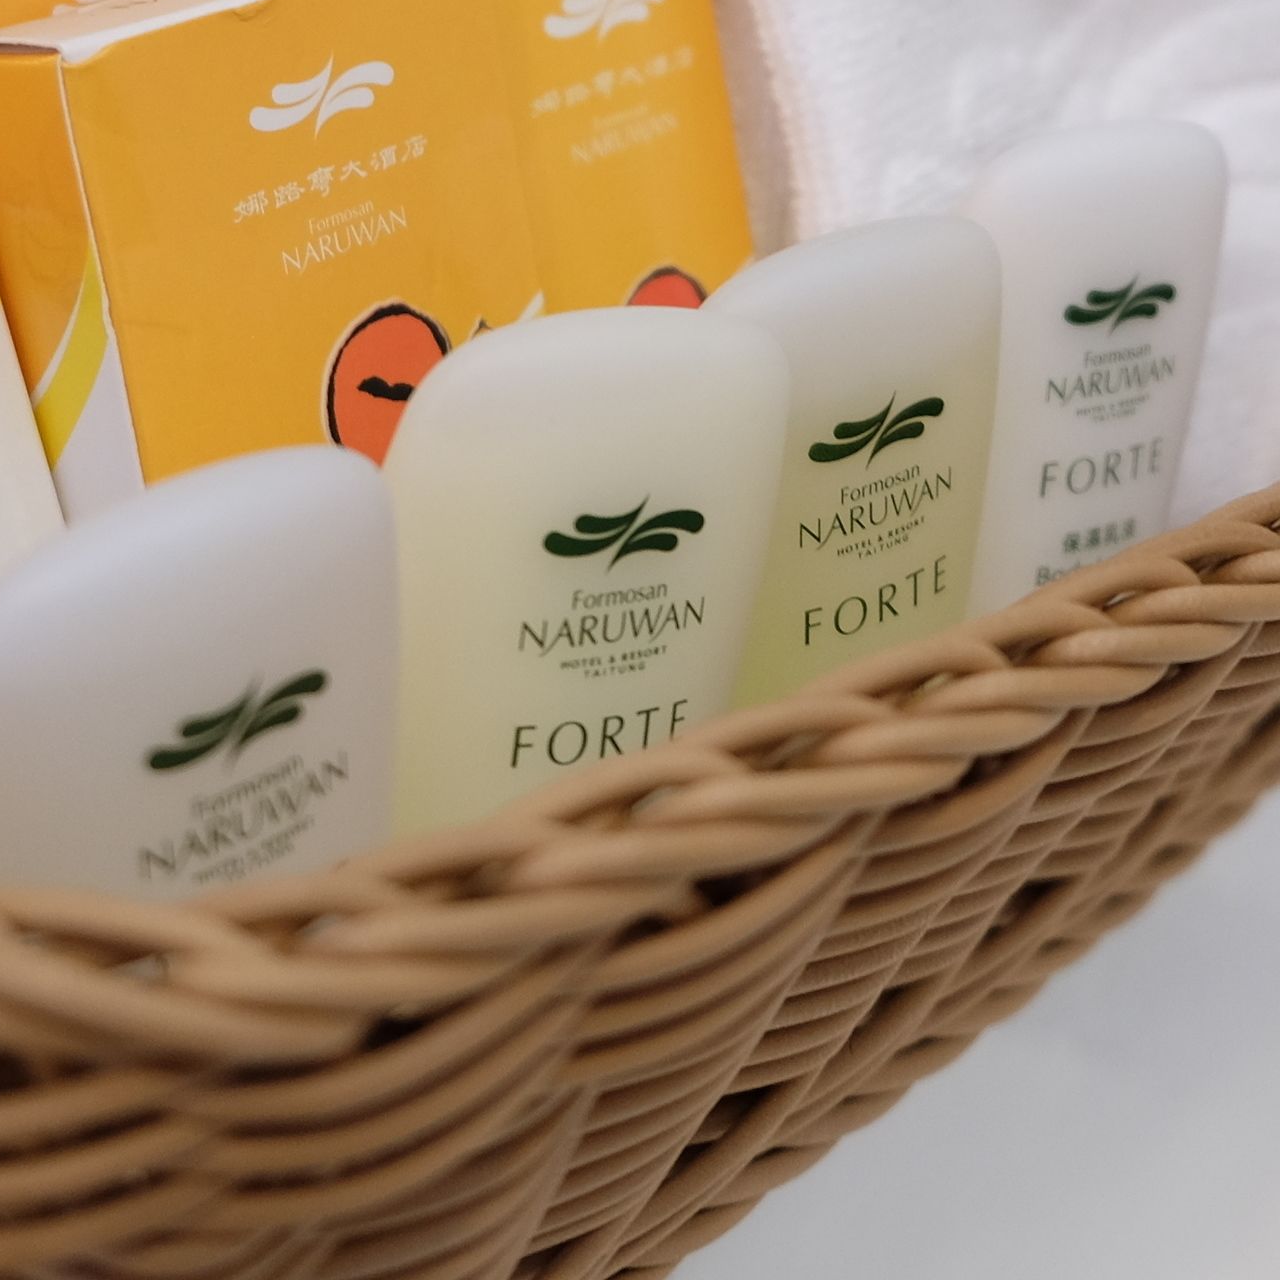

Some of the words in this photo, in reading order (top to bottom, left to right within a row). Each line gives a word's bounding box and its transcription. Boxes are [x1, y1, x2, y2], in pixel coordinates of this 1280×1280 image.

[281, 206, 408, 276] NARUWAN
[307, 199, 374, 235] Formosan
[1045, 354, 1176, 407] NARUWAN
[839, 464, 921, 506] Formosan
[1039, 436, 1165, 499] FORTE
[798, 465, 954, 550] NARUWAN
[837, 538, 872, 557] HOTEL
[858, 533, 910, 560] TAITUNG
[571, 583, 669, 611] Formosan
[803, 554, 949, 647] FORTE
[518, 596, 706, 658] NARUWAN
[583, 660, 647, 679] TAITUNG
[138, 750, 349, 880] NARUWAN
